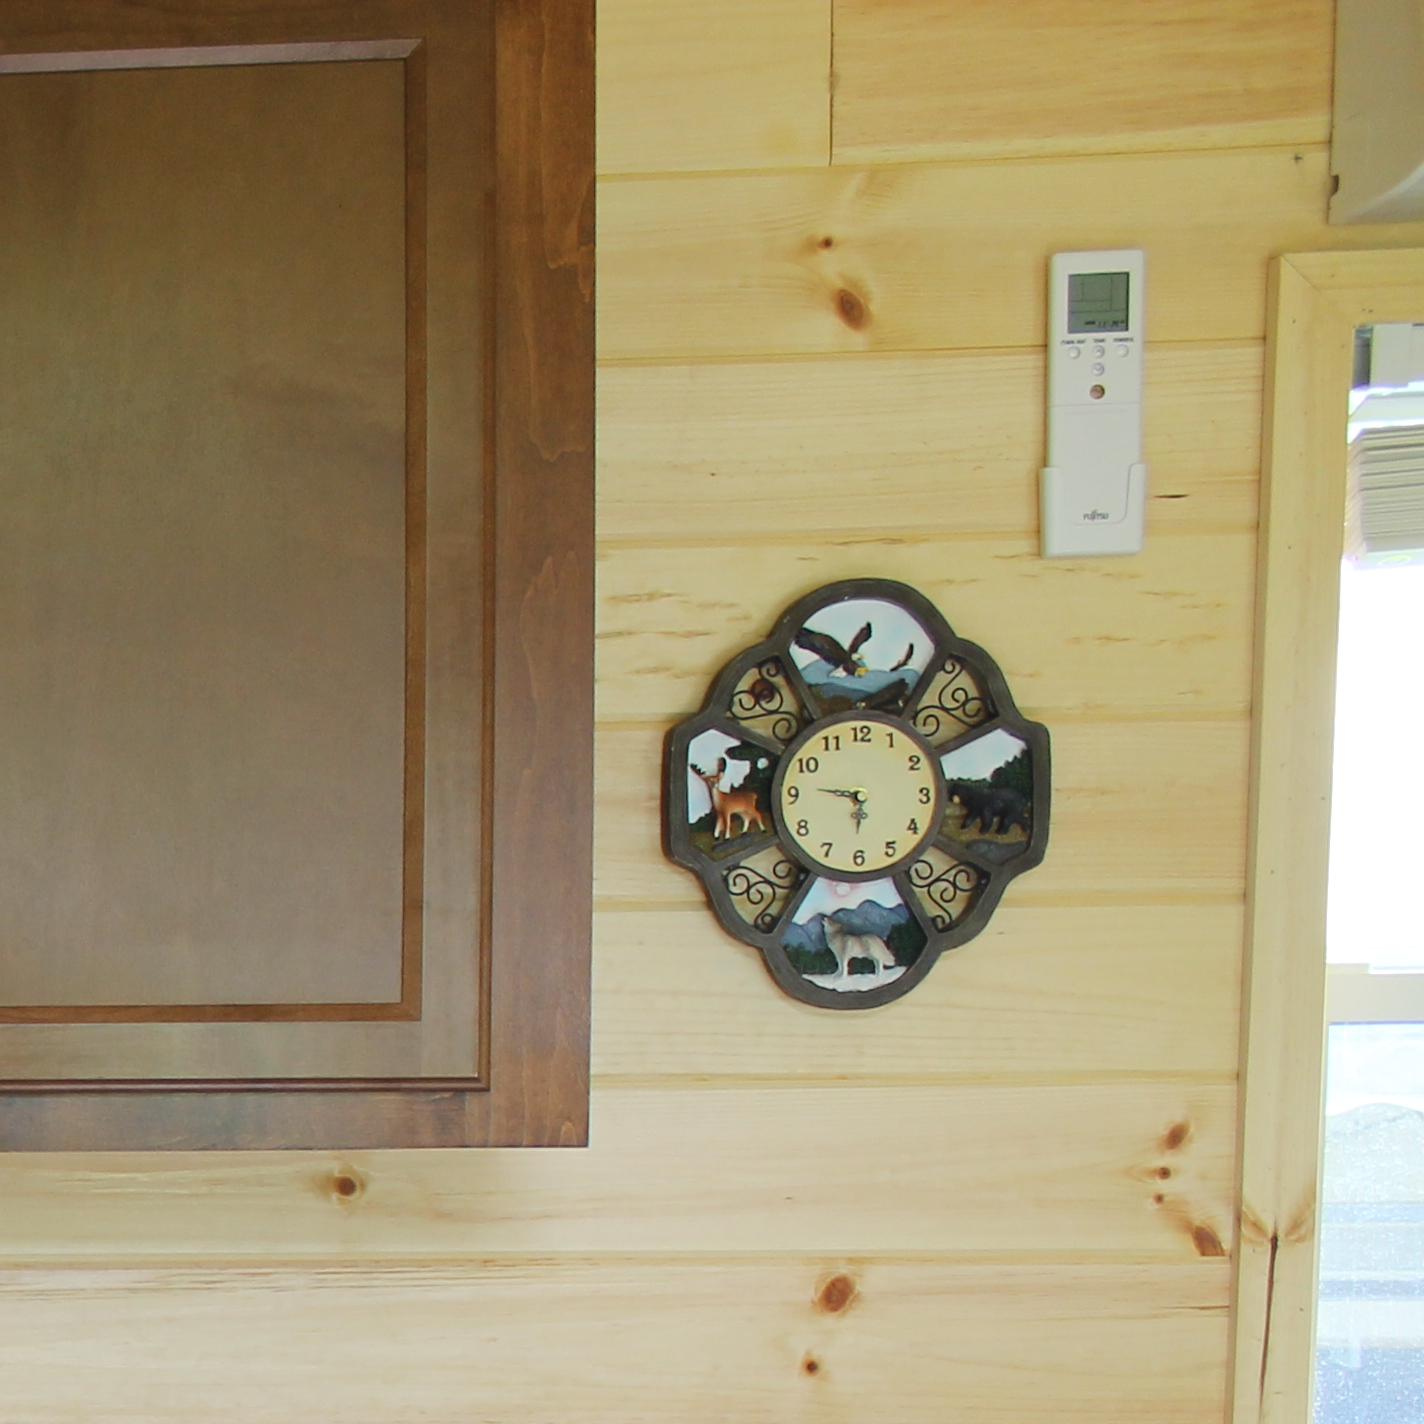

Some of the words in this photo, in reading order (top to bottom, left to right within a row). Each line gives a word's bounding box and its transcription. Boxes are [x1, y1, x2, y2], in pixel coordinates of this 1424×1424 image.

[851, 725, 872, 743] 12
[886, 732, 895, 748] 1
[821, 735, 841, 751] 11
[797, 756, 819, 773] 10
[908, 755, 921, 771] 2
[787, 786, 800, 804] 9
[918, 787, 931, 804] 3
[796, 819, 809, 836] 8
[907, 818, 919, 835] 4
[820, 842, 833, 858] 7
[884, 840, 897, 857] 5
[853, 850, 865, 866] 6
